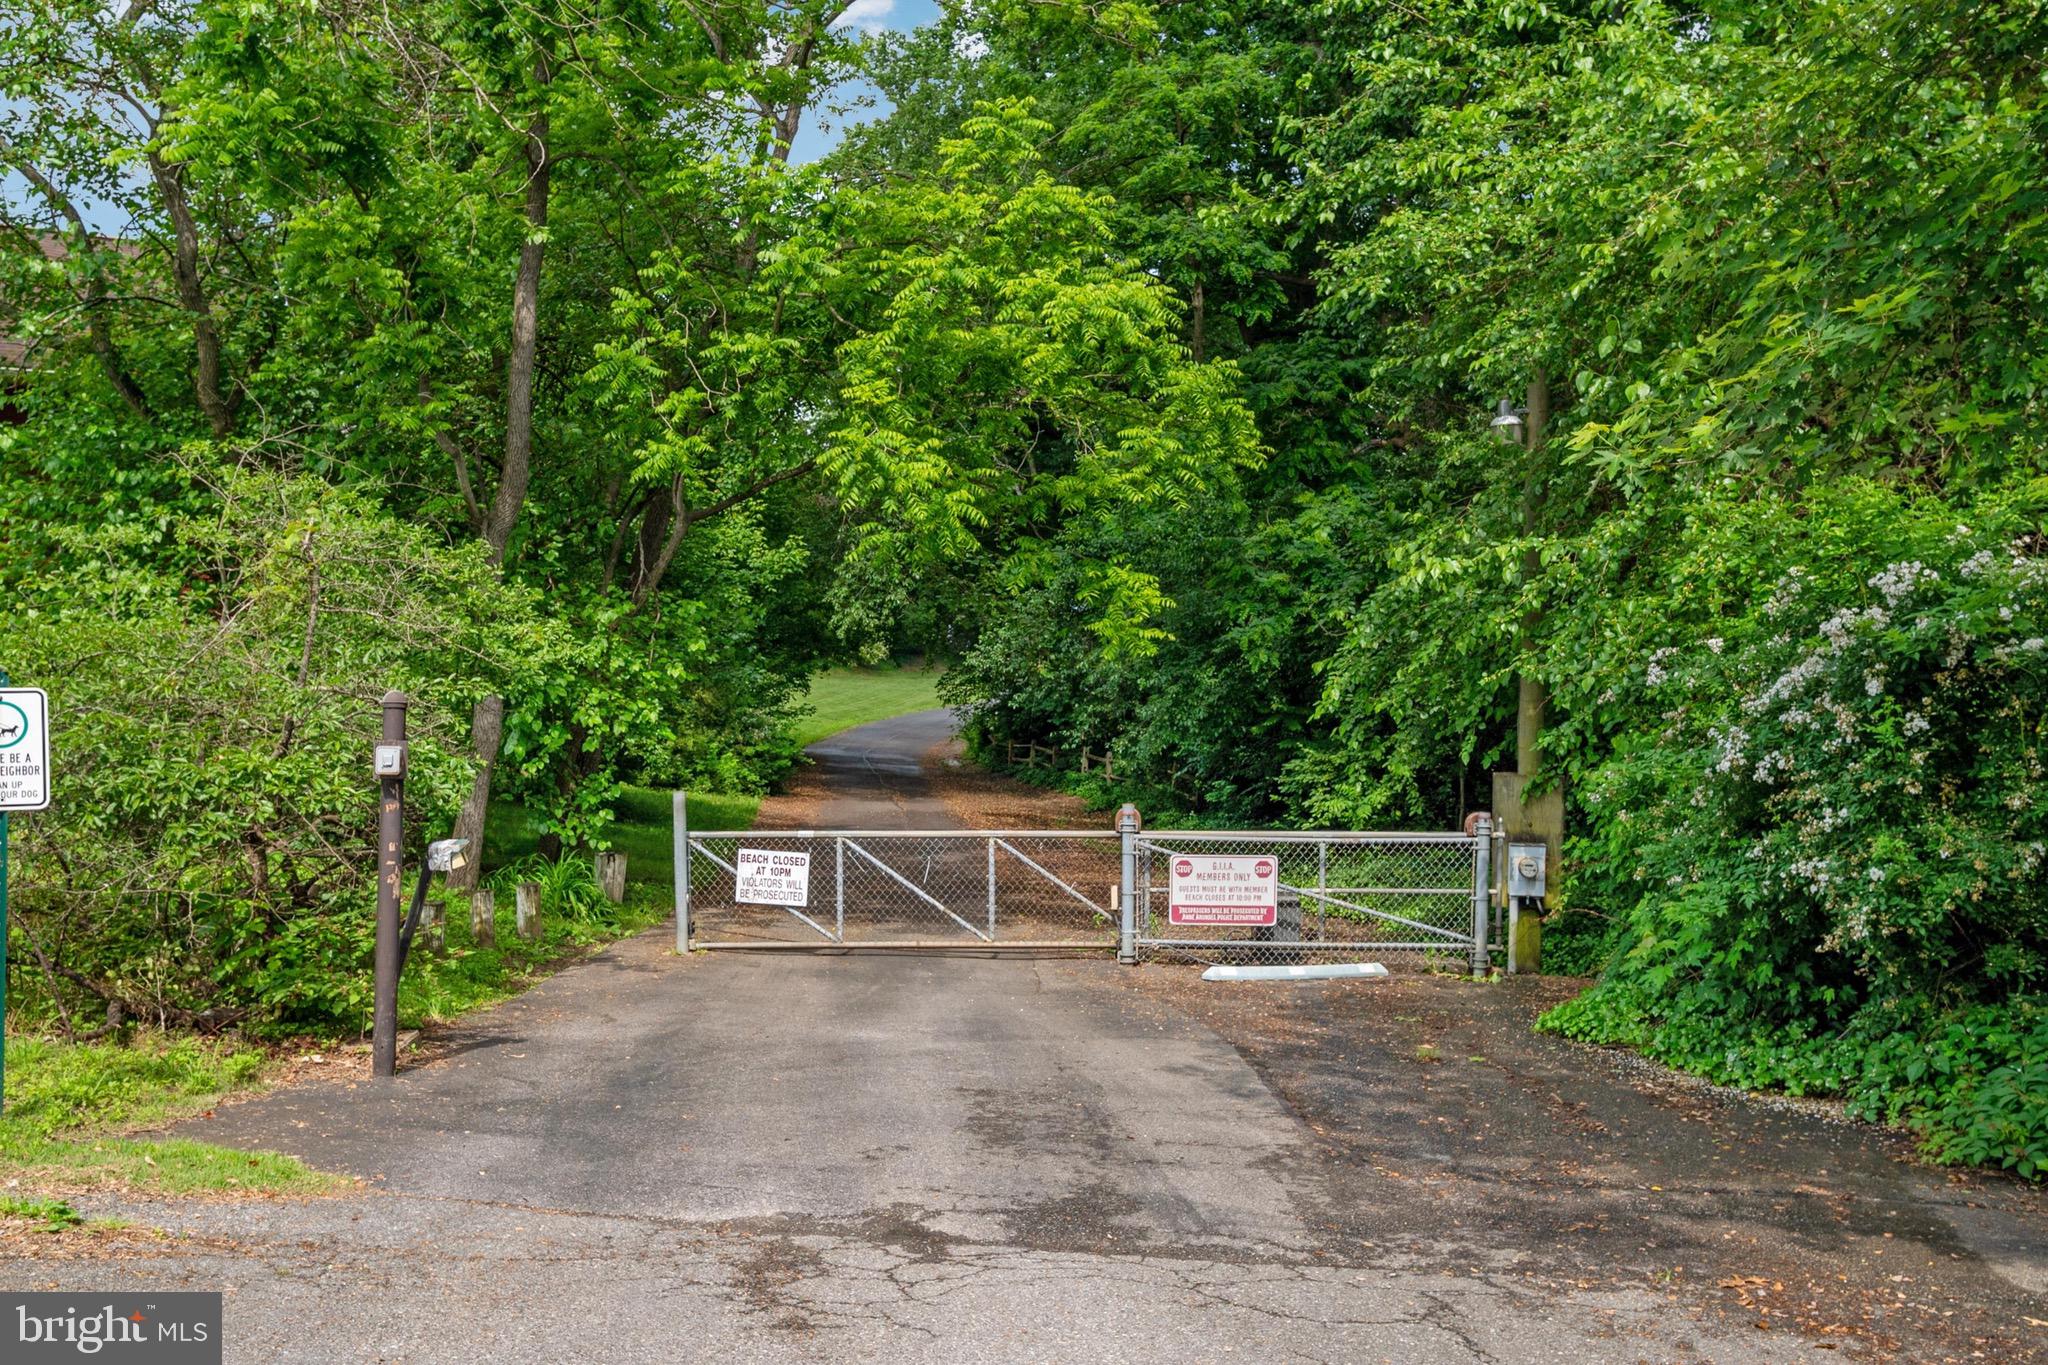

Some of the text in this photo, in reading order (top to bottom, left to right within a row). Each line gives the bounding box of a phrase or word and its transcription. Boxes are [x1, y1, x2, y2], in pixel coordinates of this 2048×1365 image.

[10, 753, 21, 763] BE
[25, 753, 31, 763] A
[0, 765, 40, 776] EIGHBOR
[740, 854, 806, 866] BEACH CLOSED
[756, 866, 791, 877] AT 10PM
[1176, 865, 1192, 873] STOP
[1255, 866, 1272, 874] STOP
[1196, 873, 1251, 881] MEMBERS ONLY
[742, 877, 802, 890] VIOLATORS WILL
[740, 889, 803, 901] BE PROSECUTED
